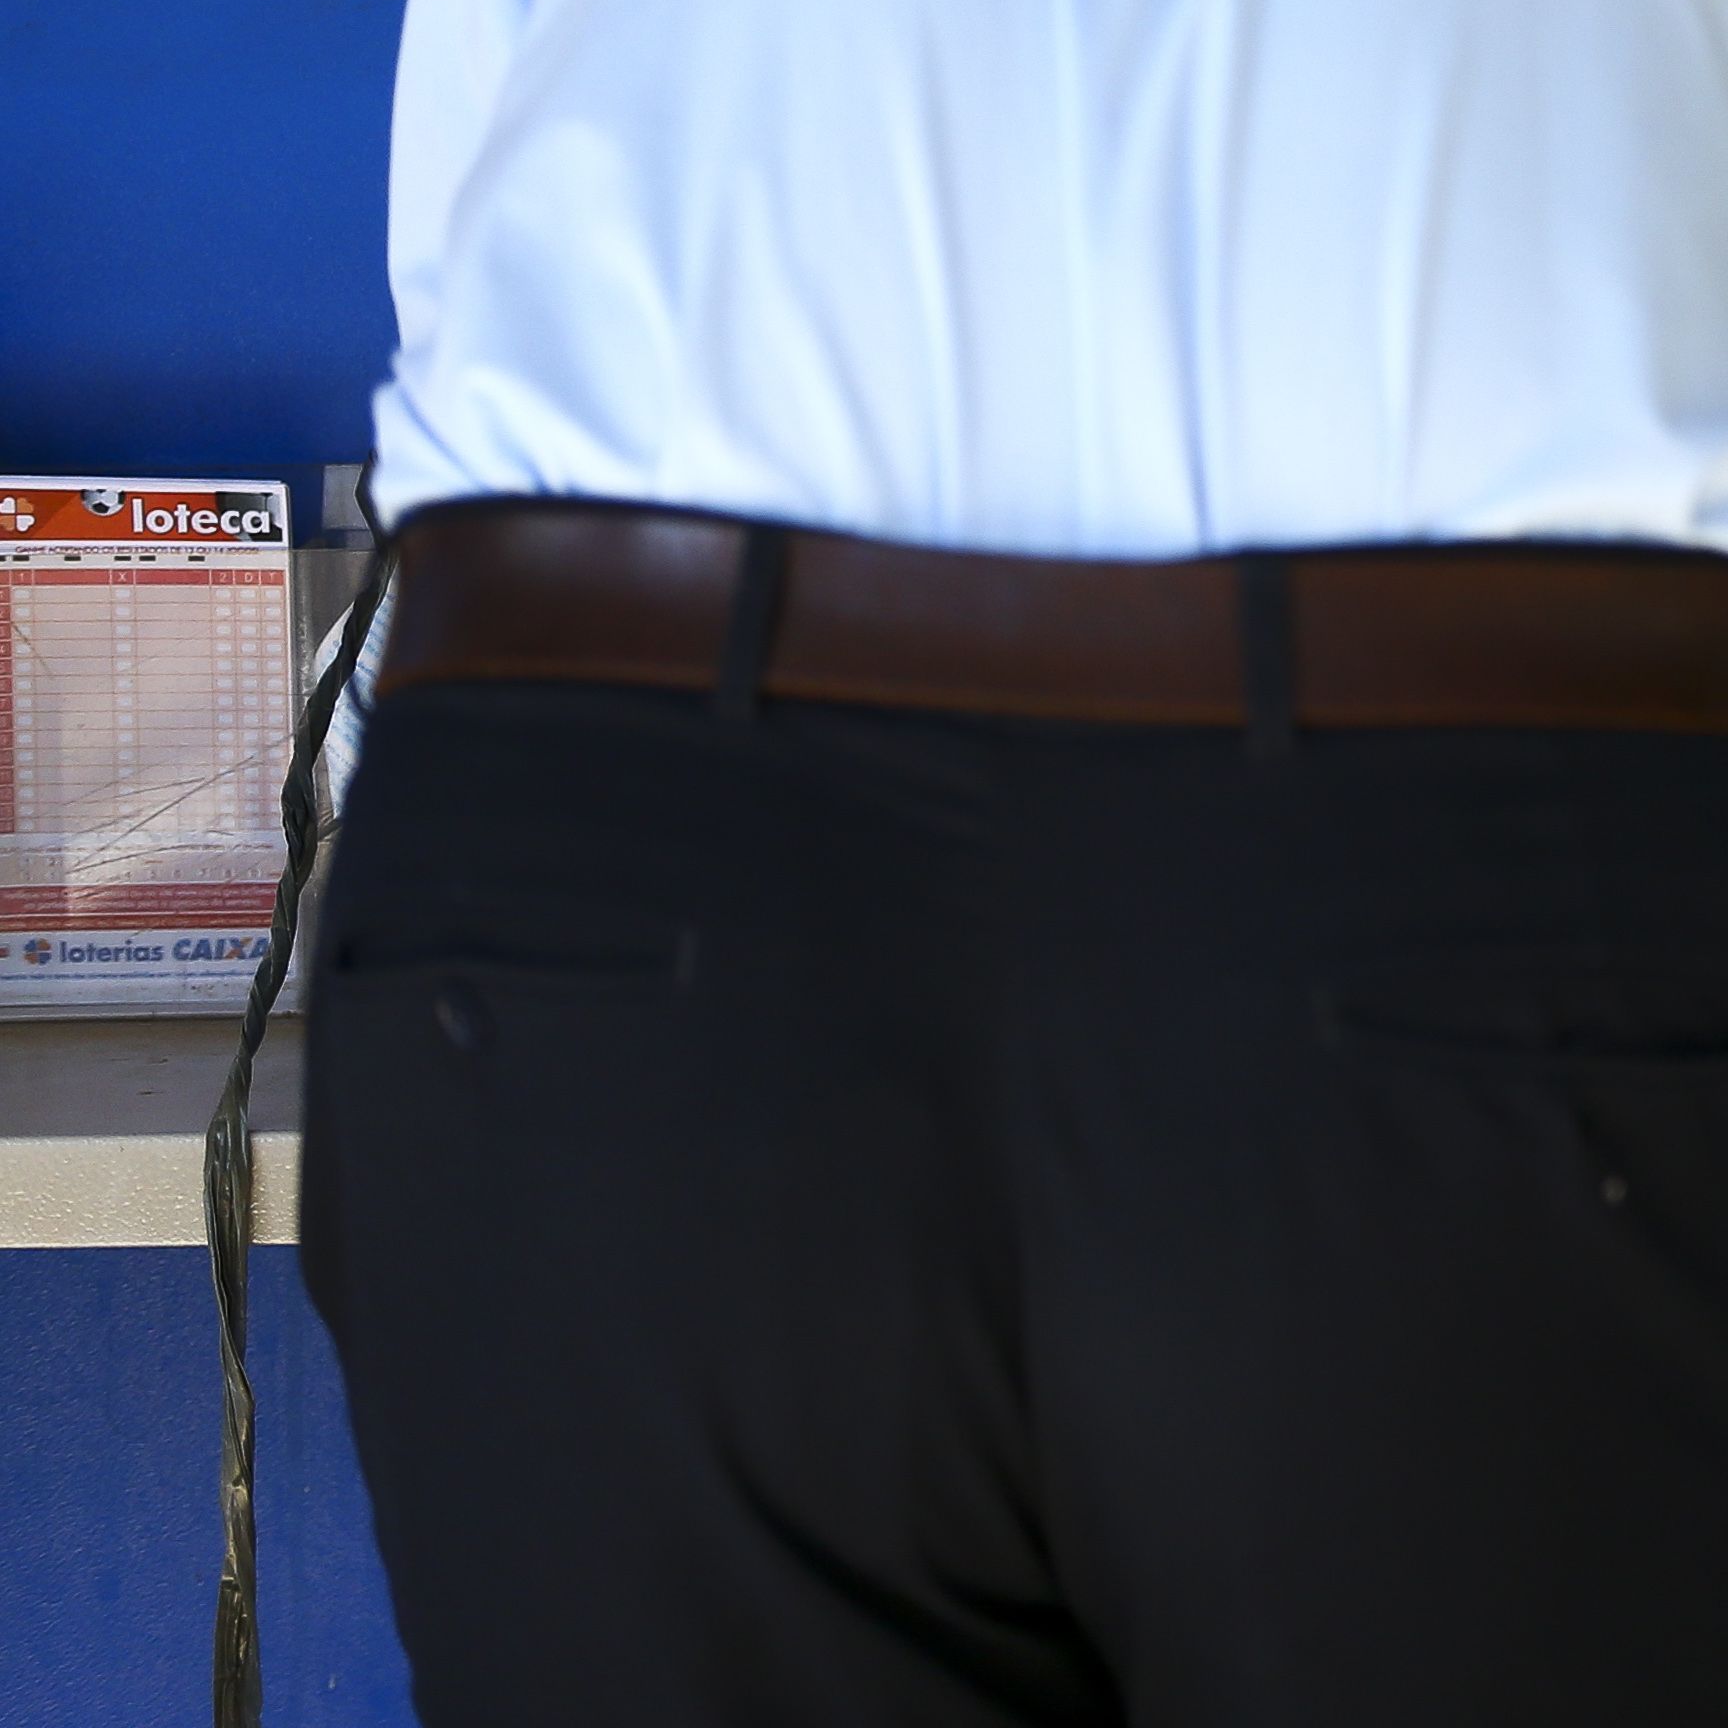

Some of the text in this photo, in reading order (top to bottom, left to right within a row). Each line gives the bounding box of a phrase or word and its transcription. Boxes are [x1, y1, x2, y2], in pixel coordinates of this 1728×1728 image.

[132, 498, 270, 534] loteca
[59, 937, 269, 962] loterias CAIXA
